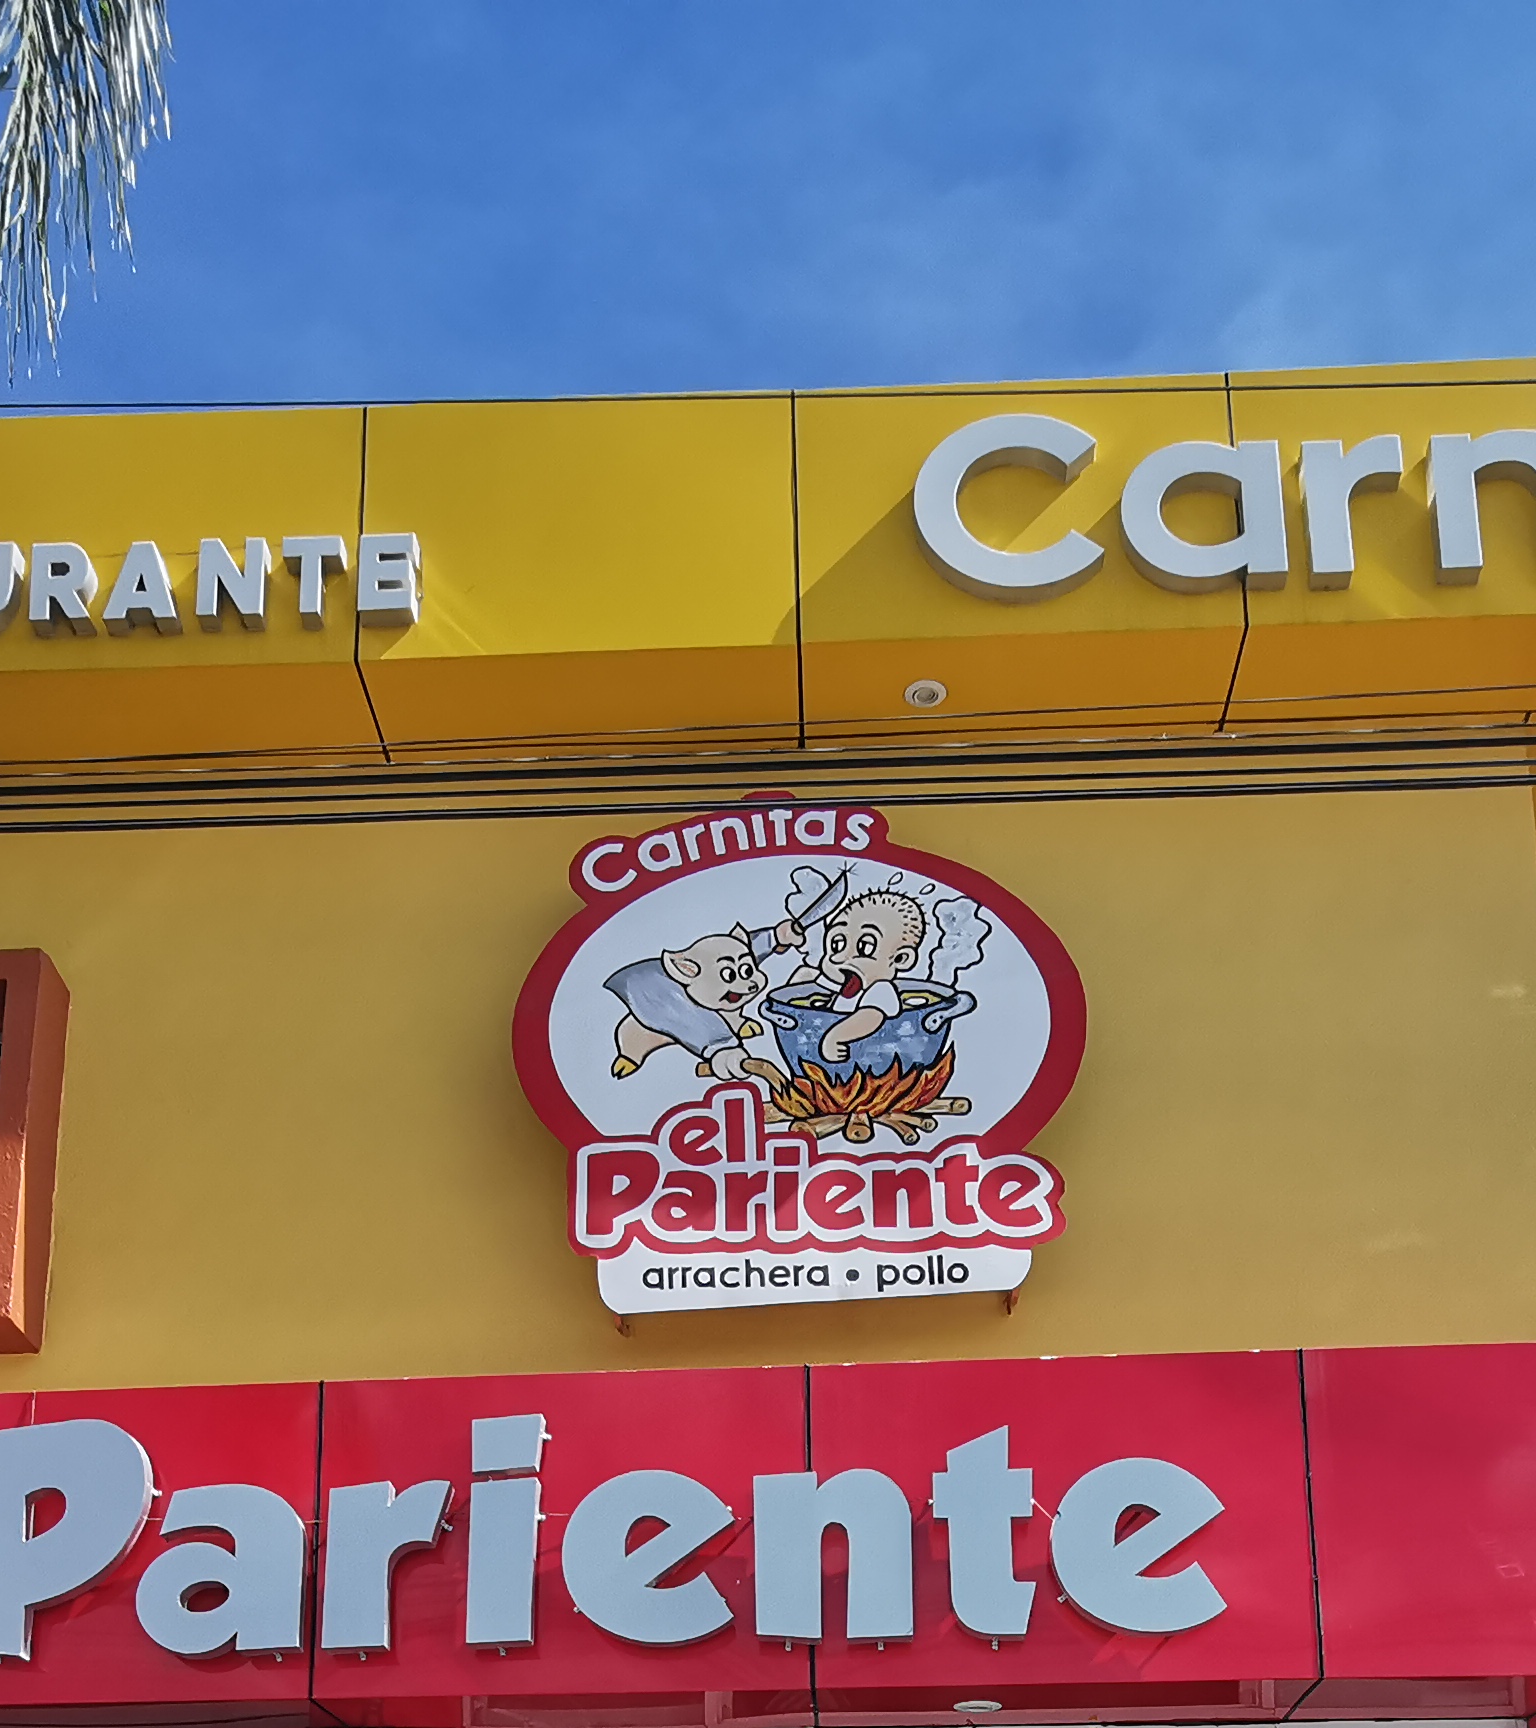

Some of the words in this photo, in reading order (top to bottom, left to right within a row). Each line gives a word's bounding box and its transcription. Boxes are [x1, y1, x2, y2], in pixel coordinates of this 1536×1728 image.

[581, 808, 875, 892] Carnitas
[669, 1097, 750, 1164] el
[585, 1144, 1054, 1238] Pariente
[642, 1256, 830, 1290] arrachera
[876, 1254, 970, 1292] pollo
